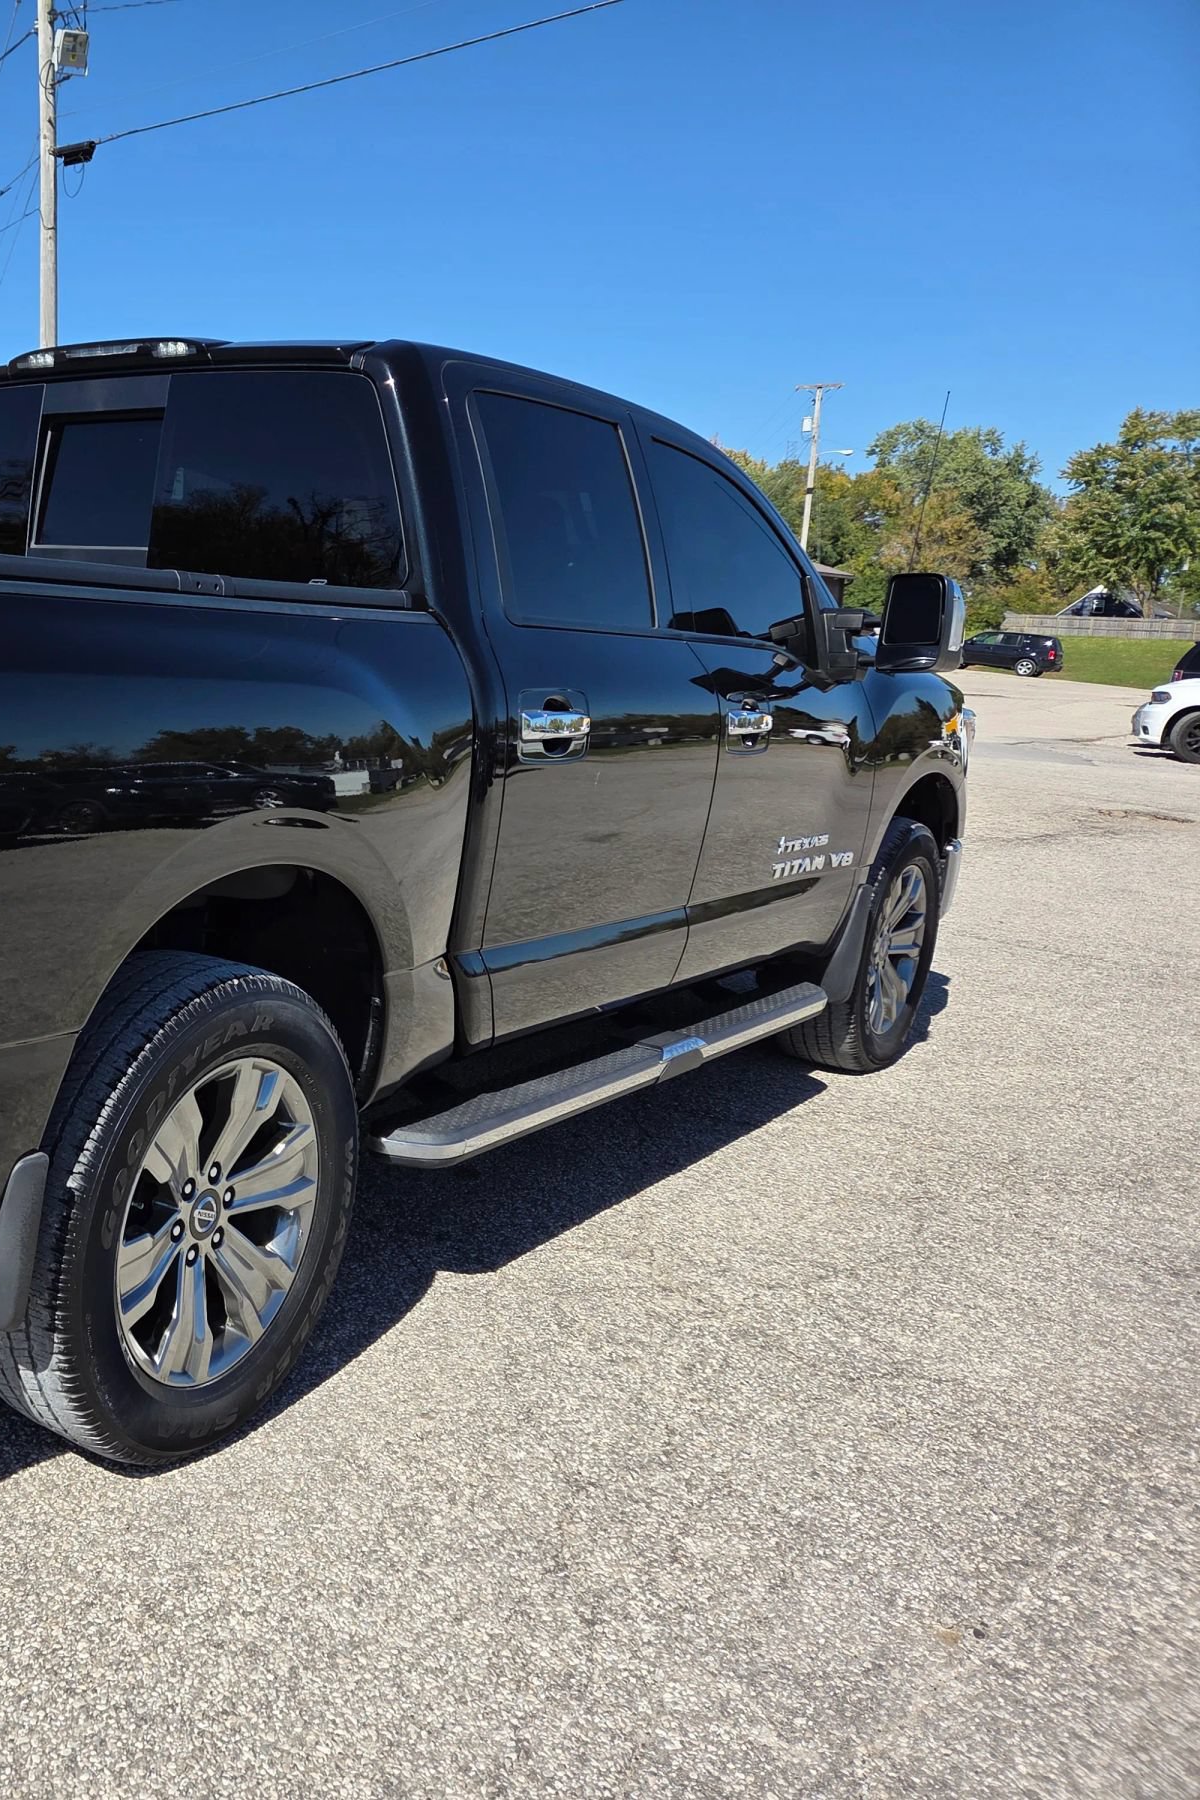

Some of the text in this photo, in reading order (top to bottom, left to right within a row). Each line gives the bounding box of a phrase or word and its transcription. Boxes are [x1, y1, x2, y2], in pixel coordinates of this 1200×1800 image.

[786, 834, 830, 854] TEXAS
[772, 851, 854, 880] TITAN V8
